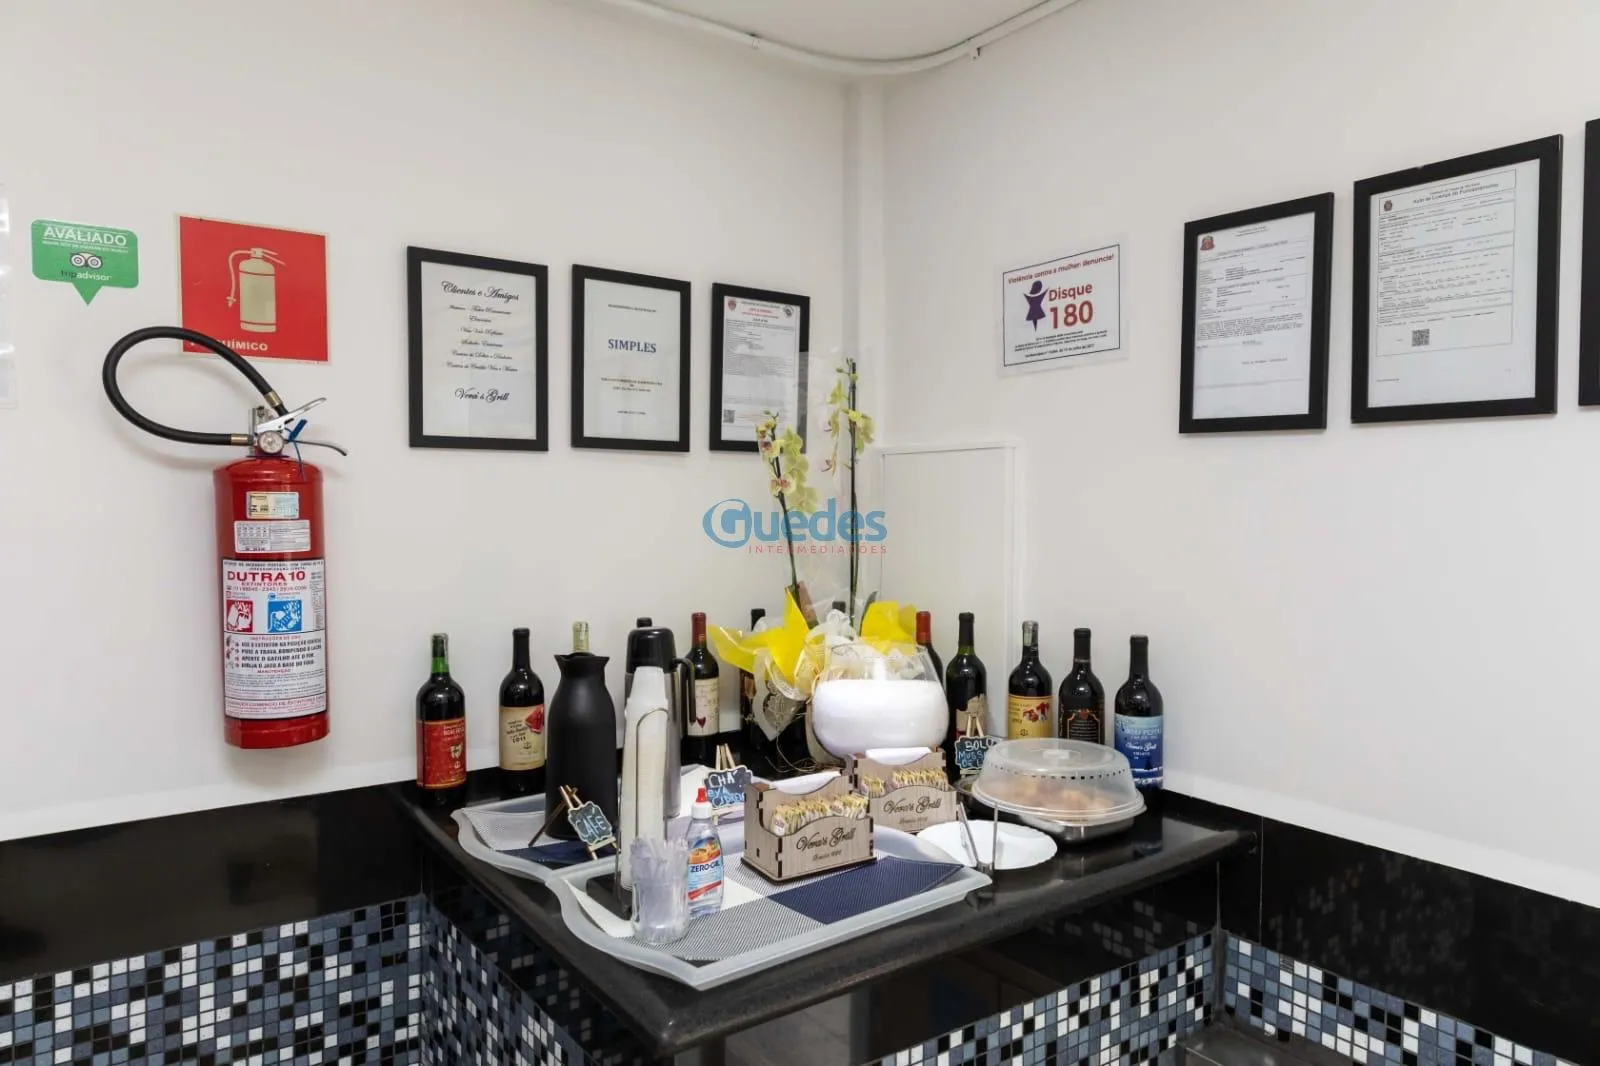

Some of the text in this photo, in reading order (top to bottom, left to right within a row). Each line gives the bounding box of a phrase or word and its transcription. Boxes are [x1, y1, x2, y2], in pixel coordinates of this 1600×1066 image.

[43, 226, 127, 247] AVALIADO
[60, 269, 112, 281] tripadvisor
[441, 280, 519, 304] Clientes e Amigos
[1048, 283, 1093, 302] Disque
[1050, 300, 1093, 329] 180
[607, 338, 657, 354] SIMPLES
[485, 388, 511, 403] Grill
[227, 571, 306, 581] DUTRA 10
[708, 769, 738, 788] CHÁ
[829, 827, 856, 848] Grill
